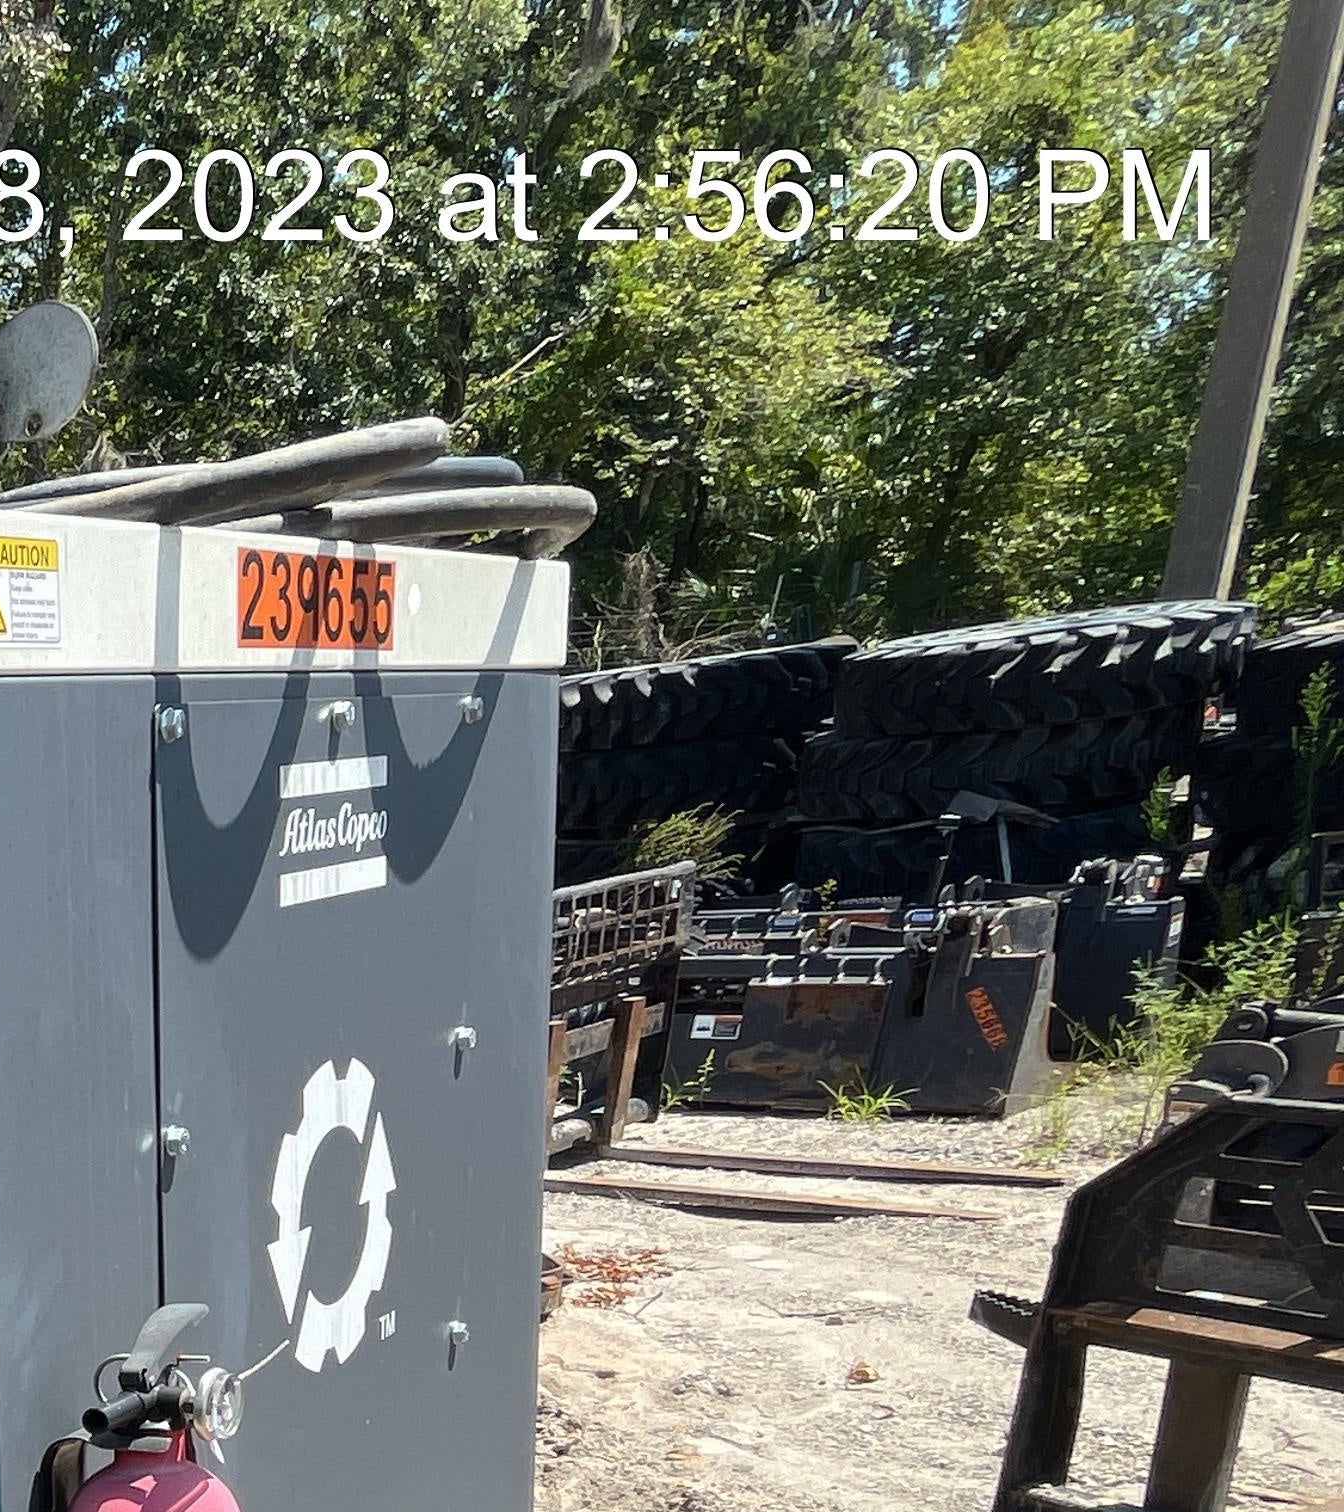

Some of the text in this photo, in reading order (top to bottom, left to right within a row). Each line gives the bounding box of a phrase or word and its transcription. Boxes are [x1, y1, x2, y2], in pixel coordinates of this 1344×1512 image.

[242, 549, 392, 645] 239655
[279, 801, 388, 857] Atlas Copco
[378, 1310, 396, 1341] TM
